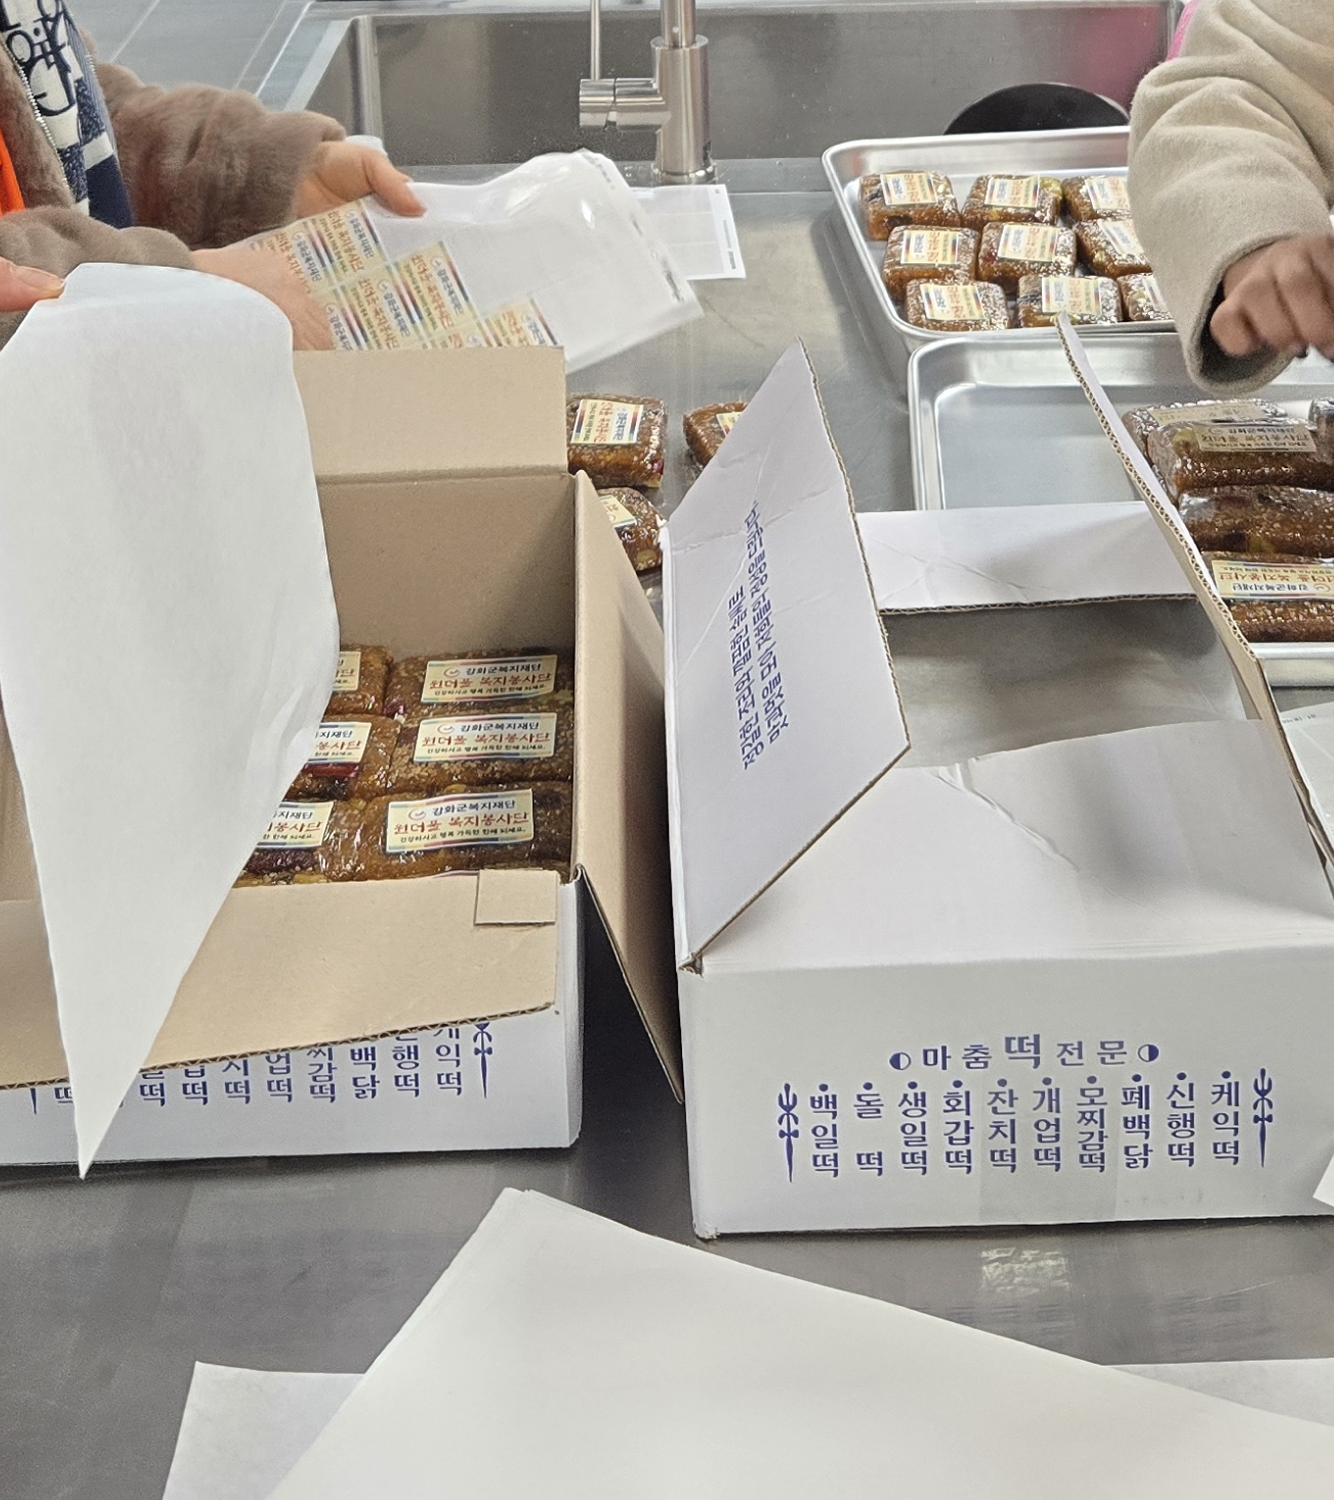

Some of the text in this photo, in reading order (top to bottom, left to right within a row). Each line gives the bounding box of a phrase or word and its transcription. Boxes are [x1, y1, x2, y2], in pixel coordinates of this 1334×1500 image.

[747, 549, 769, 598] 정성을
[750, 590, 775, 651] 저희들의
[465, 663, 541, 675] 강화군복지재단
[479, 673, 548, 686] 복지봉사단
[728, 584, 765, 771] 정갈한 조리와 깔끔한 솜씨로
[757, 640, 778, 682] 모아
[460, 720, 540, 733] 강화군복지재단
[474, 731, 550, 746] 복지봉사단
[432, 799, 515, 815] 강화군복지재단
[448, 811, 529, 828] 복지봉사단
[265, 1051, 293, 1104] 업떡
[306, 1046, 338, 1104] 찌감떡
[349, 1045, 380, 1100] 백닭
[809, 1093, 840, 1178] 백일떡
[853, 1093, 884, 1177] 돌떡
[898, 1091, 928, 1176] 생일떡
[942, 1089, 975, 1174] 회갑떡
[989, 1088, 1018, 1173] 잔치떡
[1033, 1087, 1062, 1172] 개업떡
[1077, 1087, 1107, 1172] 모찌감떡
[1121, 1084, 1153, 1170] 폐백닭
[1166, 1082, 1196, 1167] 신행떡
[1210, 1080, 1240, 1165] 케익떡
